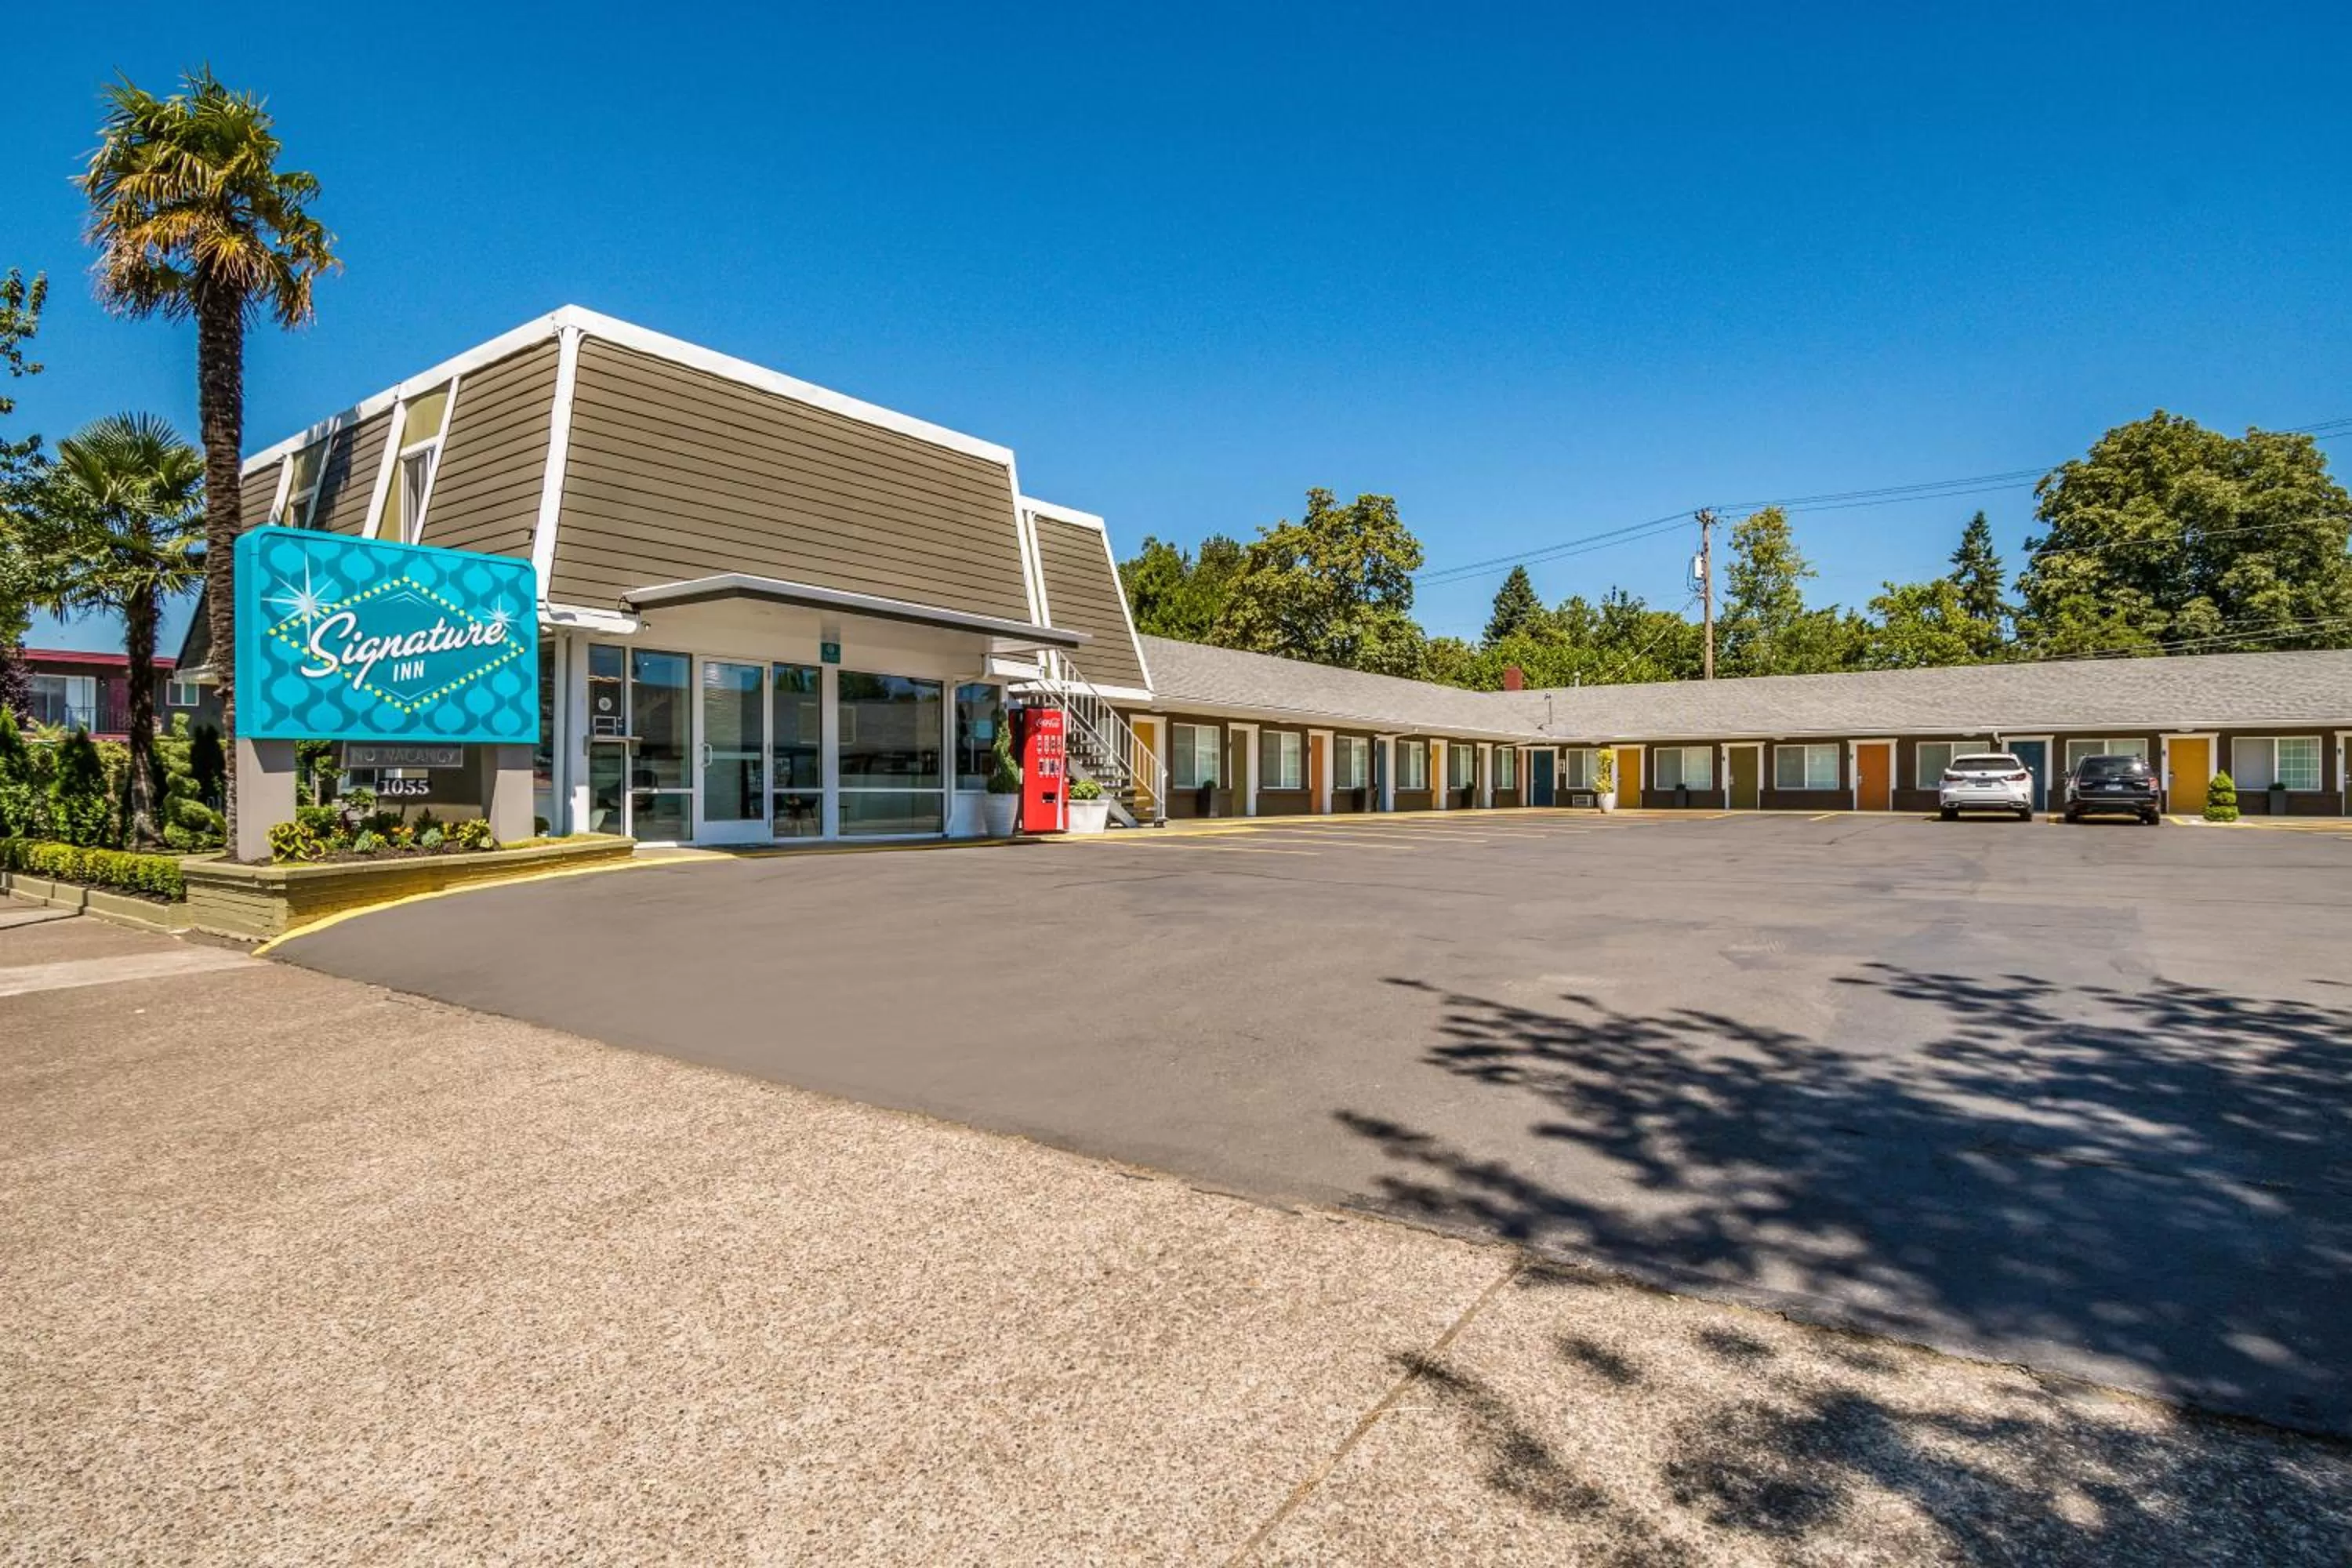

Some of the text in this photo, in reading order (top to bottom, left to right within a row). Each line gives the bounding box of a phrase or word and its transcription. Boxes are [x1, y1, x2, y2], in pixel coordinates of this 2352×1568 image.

[300, 612, 506, 690] Signature
[393, 660, 425, 682] INN
[353, 748, 455, 763] NO VACANCY
[379, 779, 430, 796] 1055
